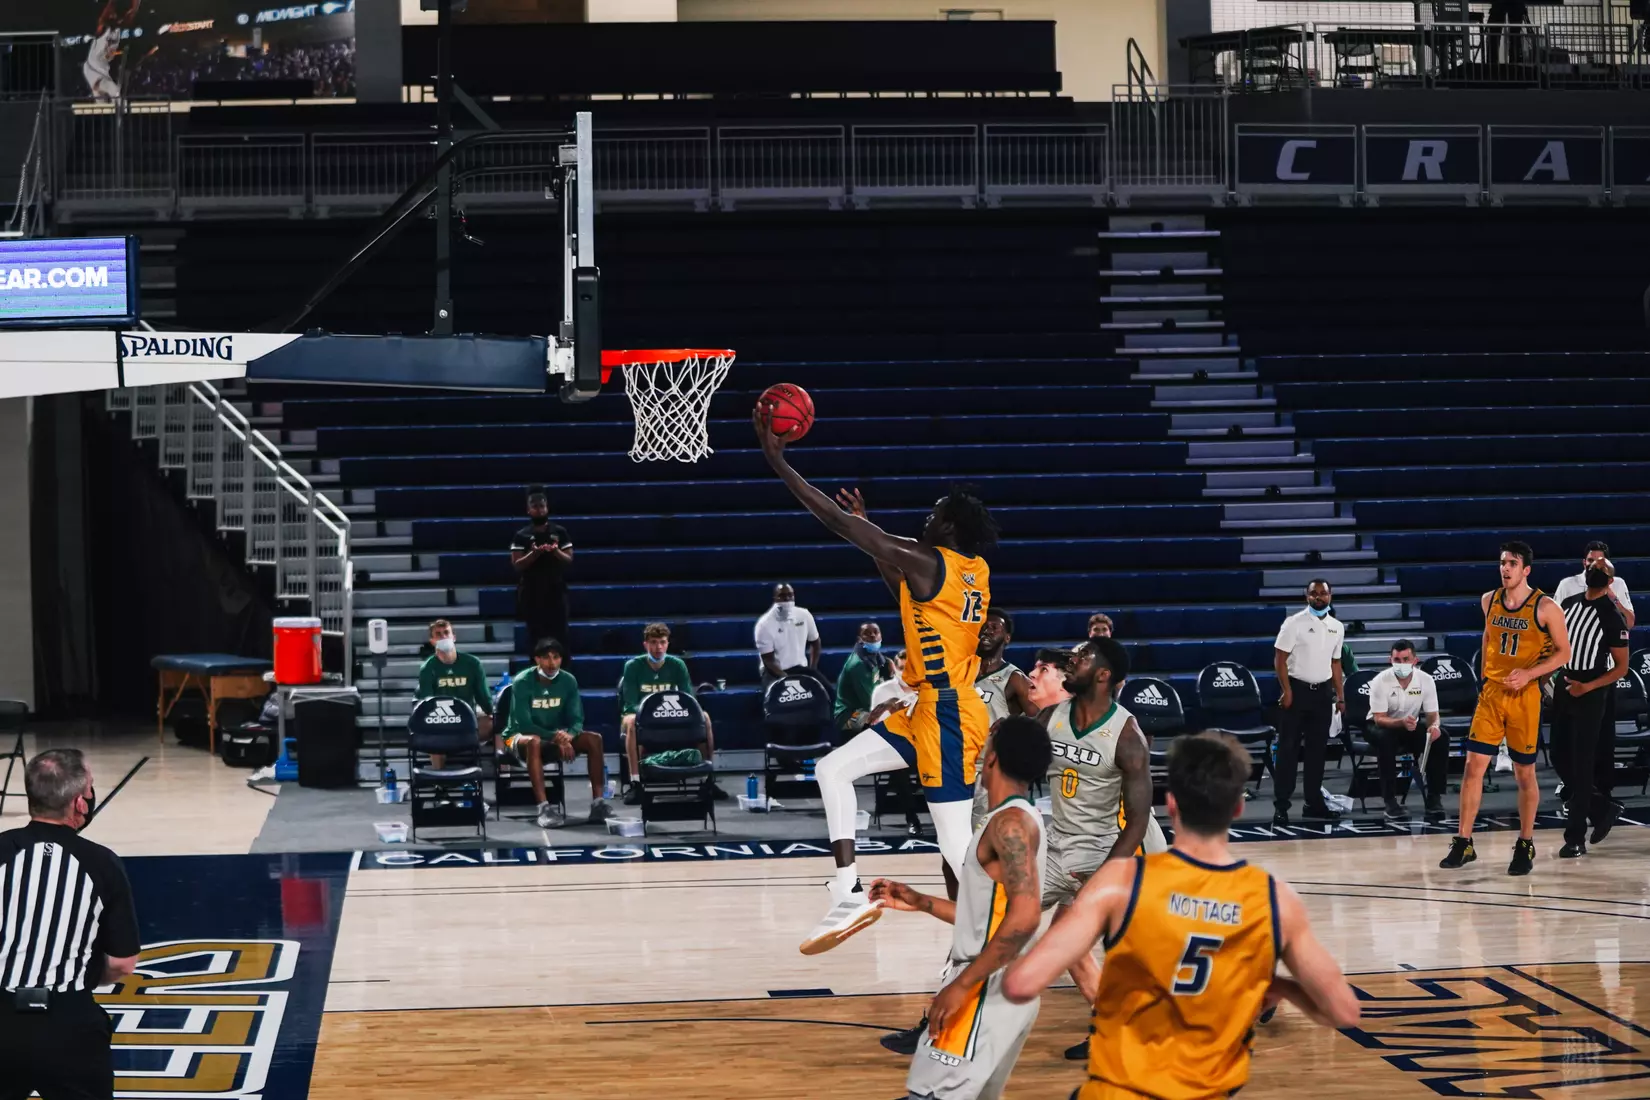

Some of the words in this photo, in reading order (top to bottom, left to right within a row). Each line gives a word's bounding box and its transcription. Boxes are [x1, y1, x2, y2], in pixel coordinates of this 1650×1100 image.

[960, 589, 982, 623] 12
[1491, 615, 1530, 630] LANCERS
[1500, 631, 1520, 657] 11
[437, 677, 468, 688] SLU
[1212, 679, 1245, 688] adidas
[531, 697, 562, 709] SLU
[778, 690, 813, 704] adidas
[1133, 696, 1169, 707] adidas
[425, 714, 462, 725] adidas
[652, 708, 690, 718] adidas
[1050, 740, 1101, 767] SLU
[1061, 768, 1079, 798] 0
[377, 842, 831, 867] CALIFORNIA
[1168, 892, 1242, 925] NOTTAGE
[1171, 933, 1224, 996] 5
[929, 1051, 961, 1067] SLU
